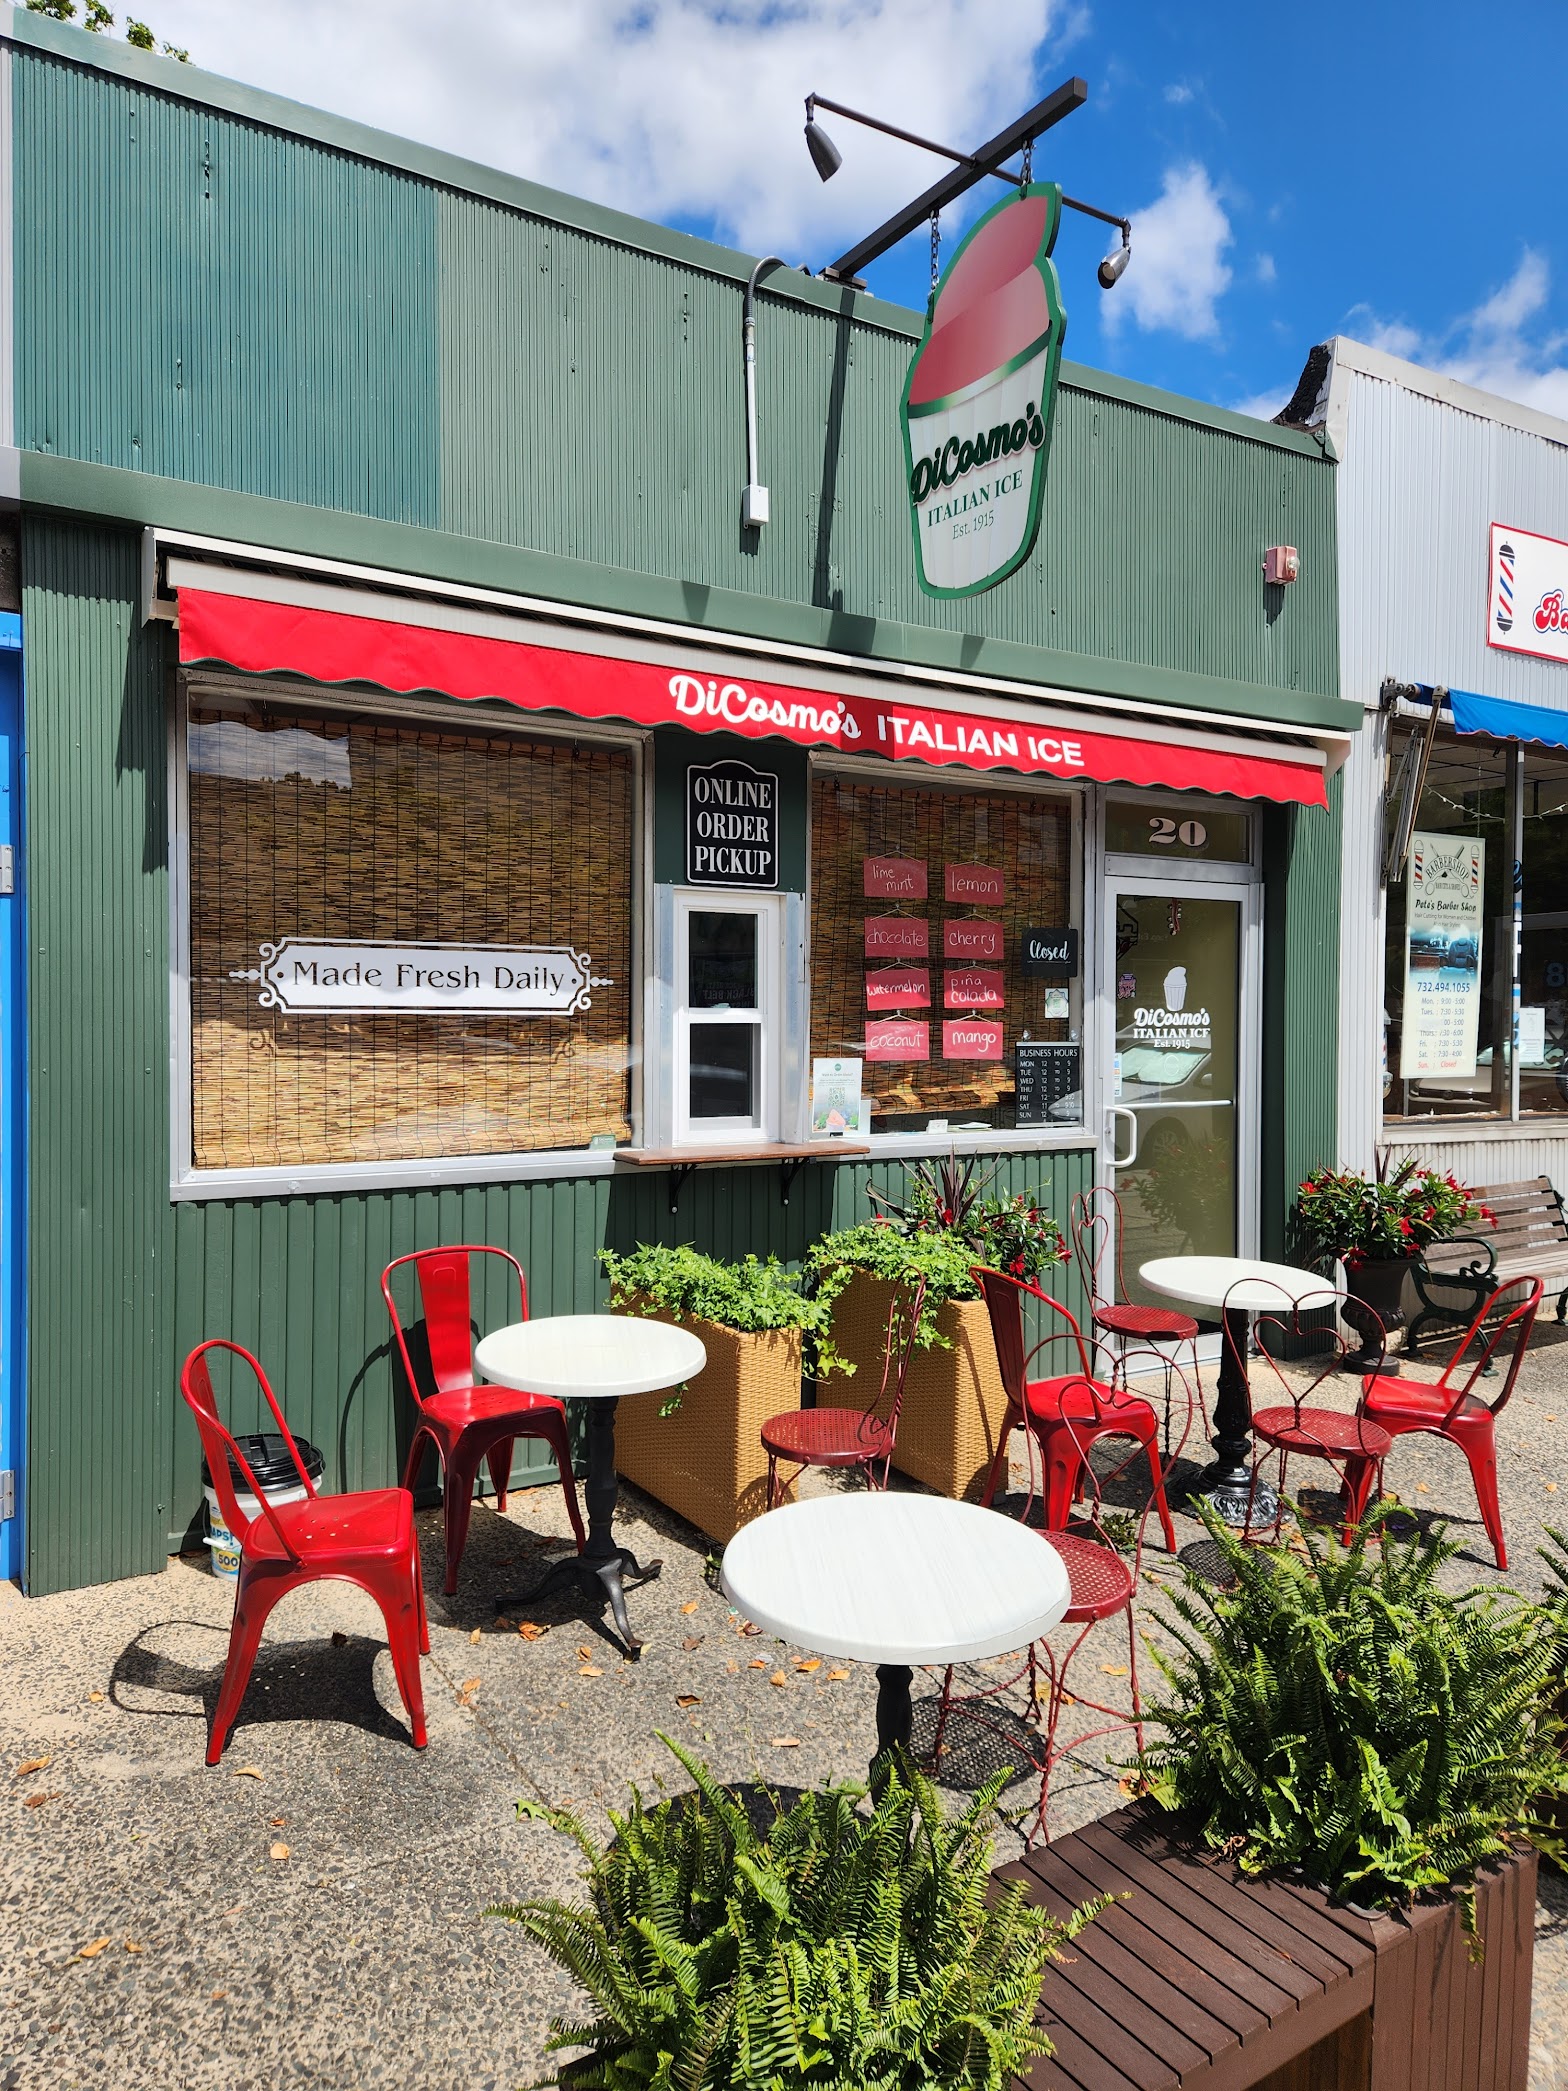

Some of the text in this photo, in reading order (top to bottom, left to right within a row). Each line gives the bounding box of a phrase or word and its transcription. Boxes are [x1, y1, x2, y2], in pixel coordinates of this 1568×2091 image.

[910, 401, 1045, 505] DiCosmo's
[927, 469, 1023, 528] ITALIAN ICE
[952, 510, 995, 540] Est. 1915
[668, 674, 1085, 768] DiCosmo's ITALIAN ICE
[694, 776, 772, 809] ONLINE
[696, 811, 770, 843] ORDER
[1148, 817, 1207, 847] 20
[694, 845, 772, 876] PICKUP
[1425, 856, 1470, 880] BARBERSHOP
[872, 864, 896, 880] lime
[951, 871, 999, 893] lemon
[886, 874, 914, 892] mint
[1415, 899, 1477, 913] Pete's Barber Shop
[866, 927, 926, 947] chocolate
[949, 930, 996, 954] cherry
[1029, 939, 1070, 961] Closed
[291, 960, 565, 996] Made Fresh Daily
[866, 979, 926, 997] watermelon
[950, 973, 983, 992] piña
[1417, 981, 1471, 993] 732.494.1055
[950, 986, 998, 1004] colada
[1133, 1007, 1211, 1027] DiCosmo's
[869, 1030, 925, 1048] coconut
[952, 1031, 997, 1053] mango
[1133, 1028, 1187, 1039] ITALIAN
[1019, 1048, 1078, 1057] BUSINESS HOURS
[1153, 1039, 1191, 1049] Est. 1915
[1020, 1077, 1035, 1085] WED
[1019, 1111, 1032, 1119] SUN
[218, 1553, 239, 1568] 500
